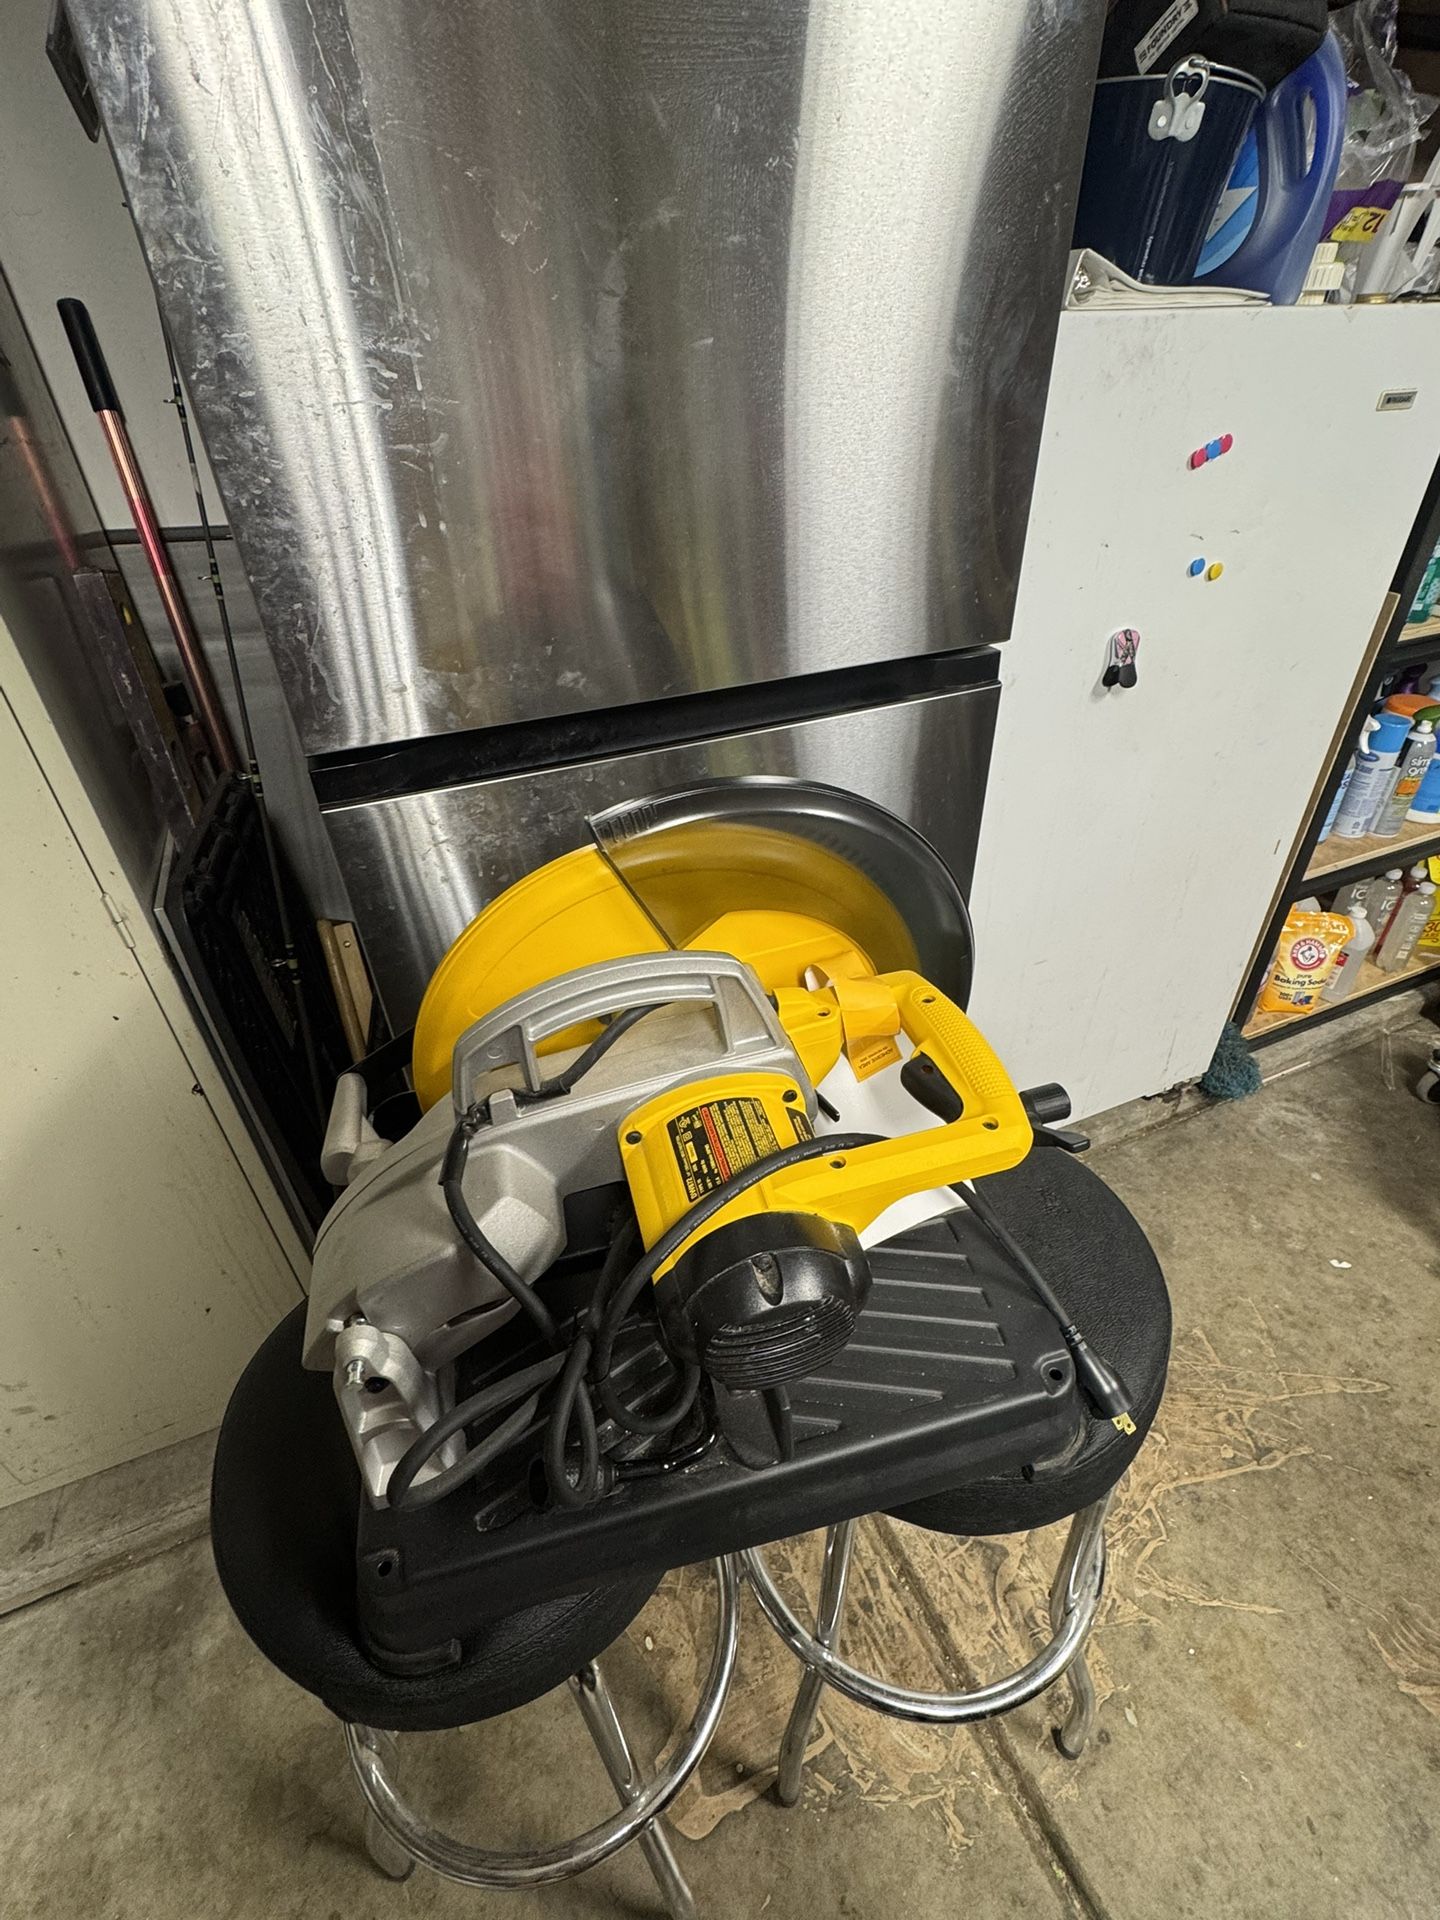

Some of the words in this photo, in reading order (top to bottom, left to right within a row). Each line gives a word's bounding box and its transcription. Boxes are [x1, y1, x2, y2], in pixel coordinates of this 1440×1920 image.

[1145, 7, 1182, 55] FOUNDRY
[1273, 974, 1307, 987] Baking
[1296, 972, 1312, 980] pure
